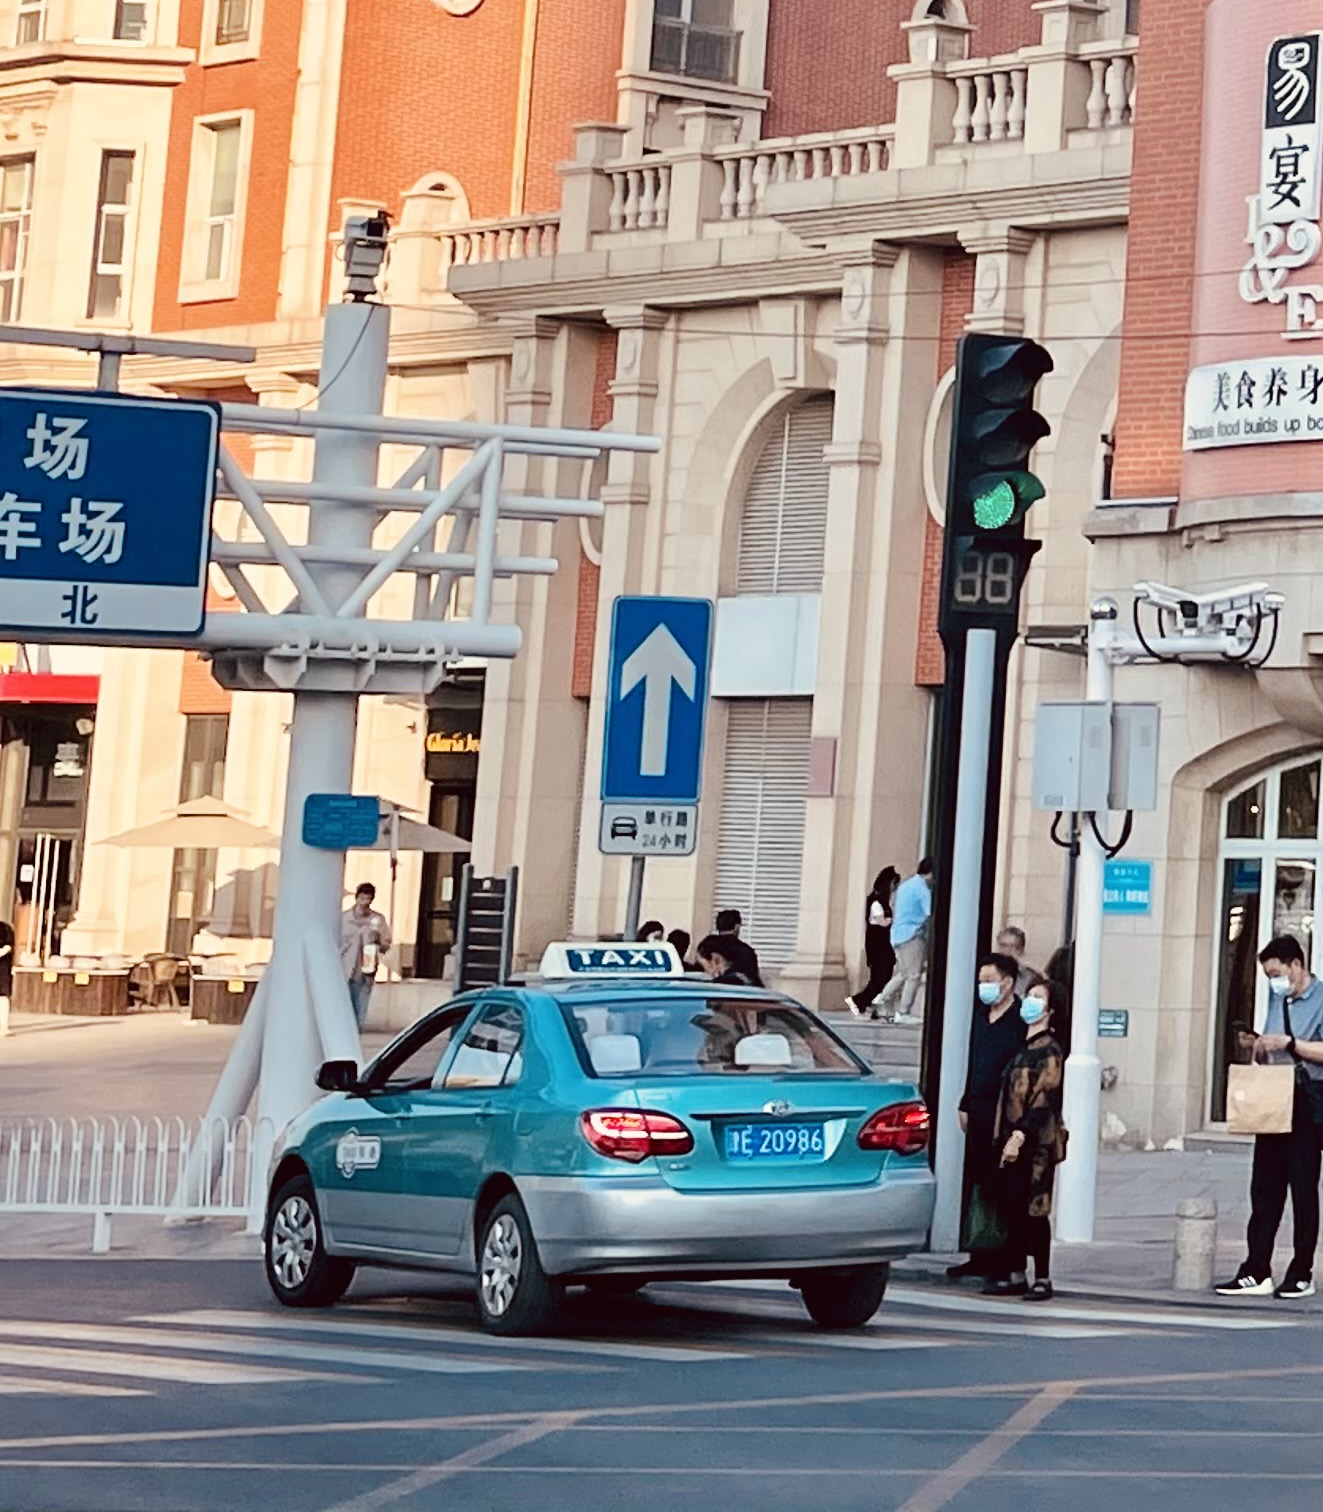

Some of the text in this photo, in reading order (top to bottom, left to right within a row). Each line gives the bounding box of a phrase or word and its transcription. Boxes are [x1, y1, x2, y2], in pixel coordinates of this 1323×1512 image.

[1217, 419, 1240, 437] food
[1244, 416, 1278, 435] builds
[1284, 418, 1301, 436] up
[24, 412, 90, 480] 场
[61, 585, 98, 625] 北
[574, 950, 665, 965] TAXI
[759, 1128, 823, 1154] 20986
